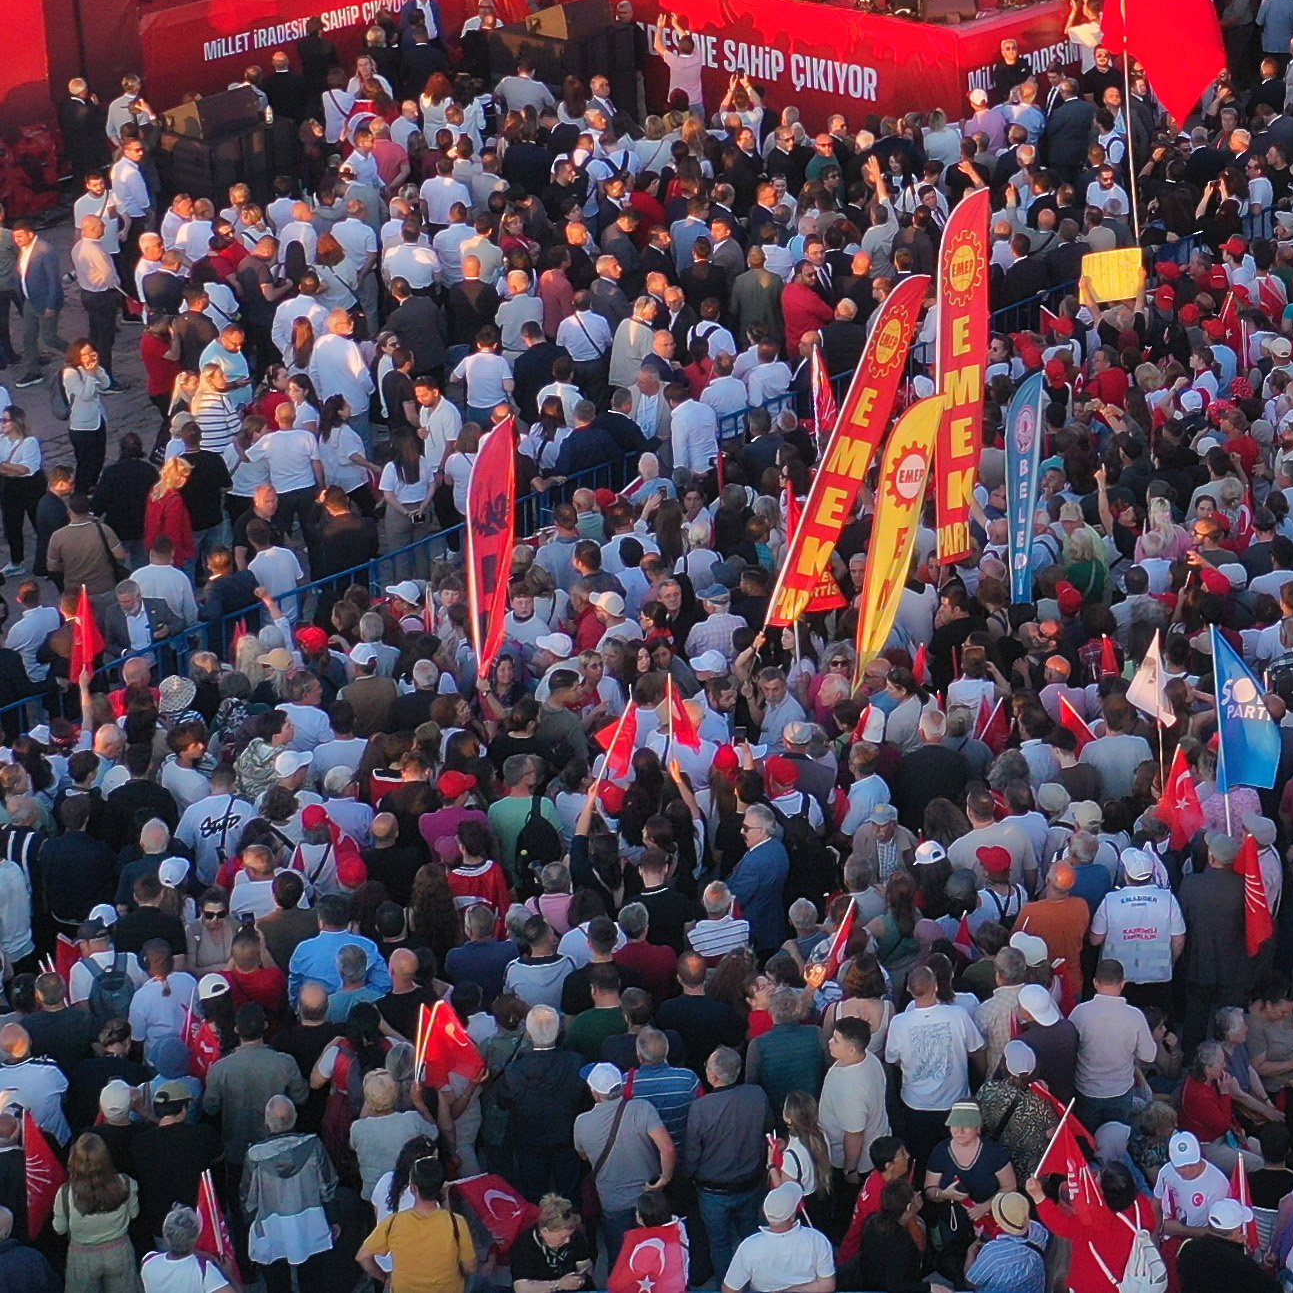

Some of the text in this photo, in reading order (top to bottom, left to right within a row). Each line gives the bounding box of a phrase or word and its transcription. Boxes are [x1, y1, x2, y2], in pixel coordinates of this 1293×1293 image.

[203, 5, 360, 62] MİLLET SAHİP
[723, 39, 878, 102] SAHİP ÇIKIYOR
[950, 258, 976, 276] EMEP
[879, 330, 899, 348] EMEP
[943, 314, 981, 510] EMEK
[796, 386, 879, 577] EMEK
[898, 466, 926, 484] EMEP
